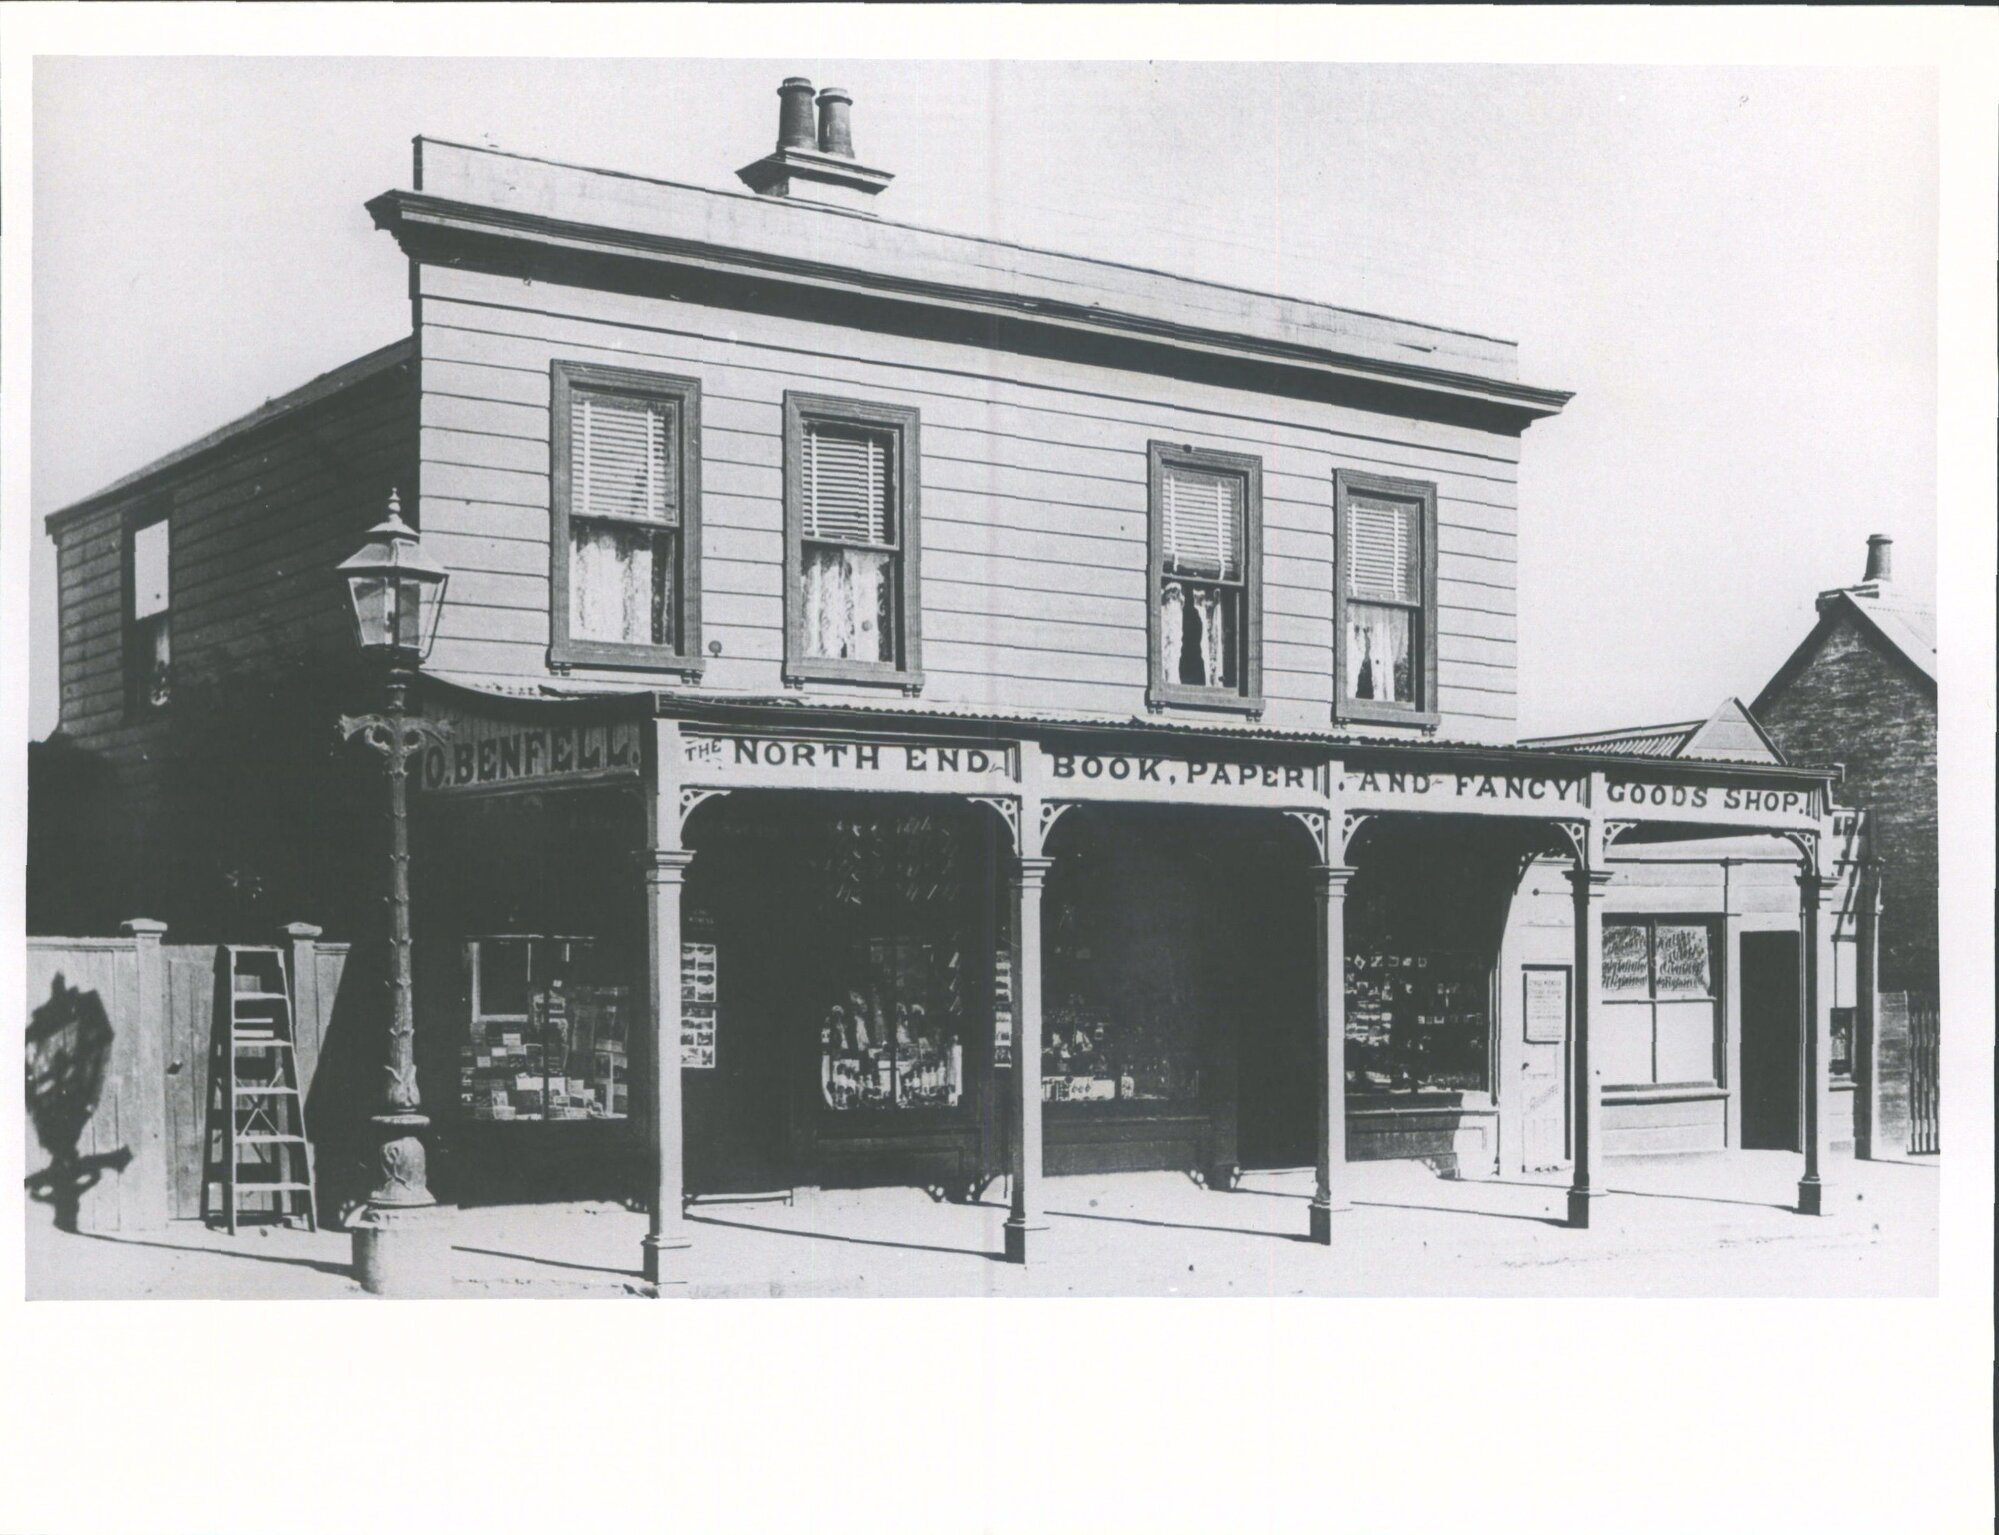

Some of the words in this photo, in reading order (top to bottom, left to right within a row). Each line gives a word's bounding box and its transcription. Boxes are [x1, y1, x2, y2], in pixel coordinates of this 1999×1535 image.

[684, 739, 722, 762] THE
[733, 739, 880, 770] NORTH
[905, 748, 990, 773] END
[1052, 754, 1176, 785] BOOK,
[1186, 760, 1305, 788] PAPER
[1359, 772, 1430, 794] AND
[1456, 776, 1573, 801] FANCY
[1607, 782, 1708, 808] GOODS
[1723, 788, 1804, 815] SHOP.
